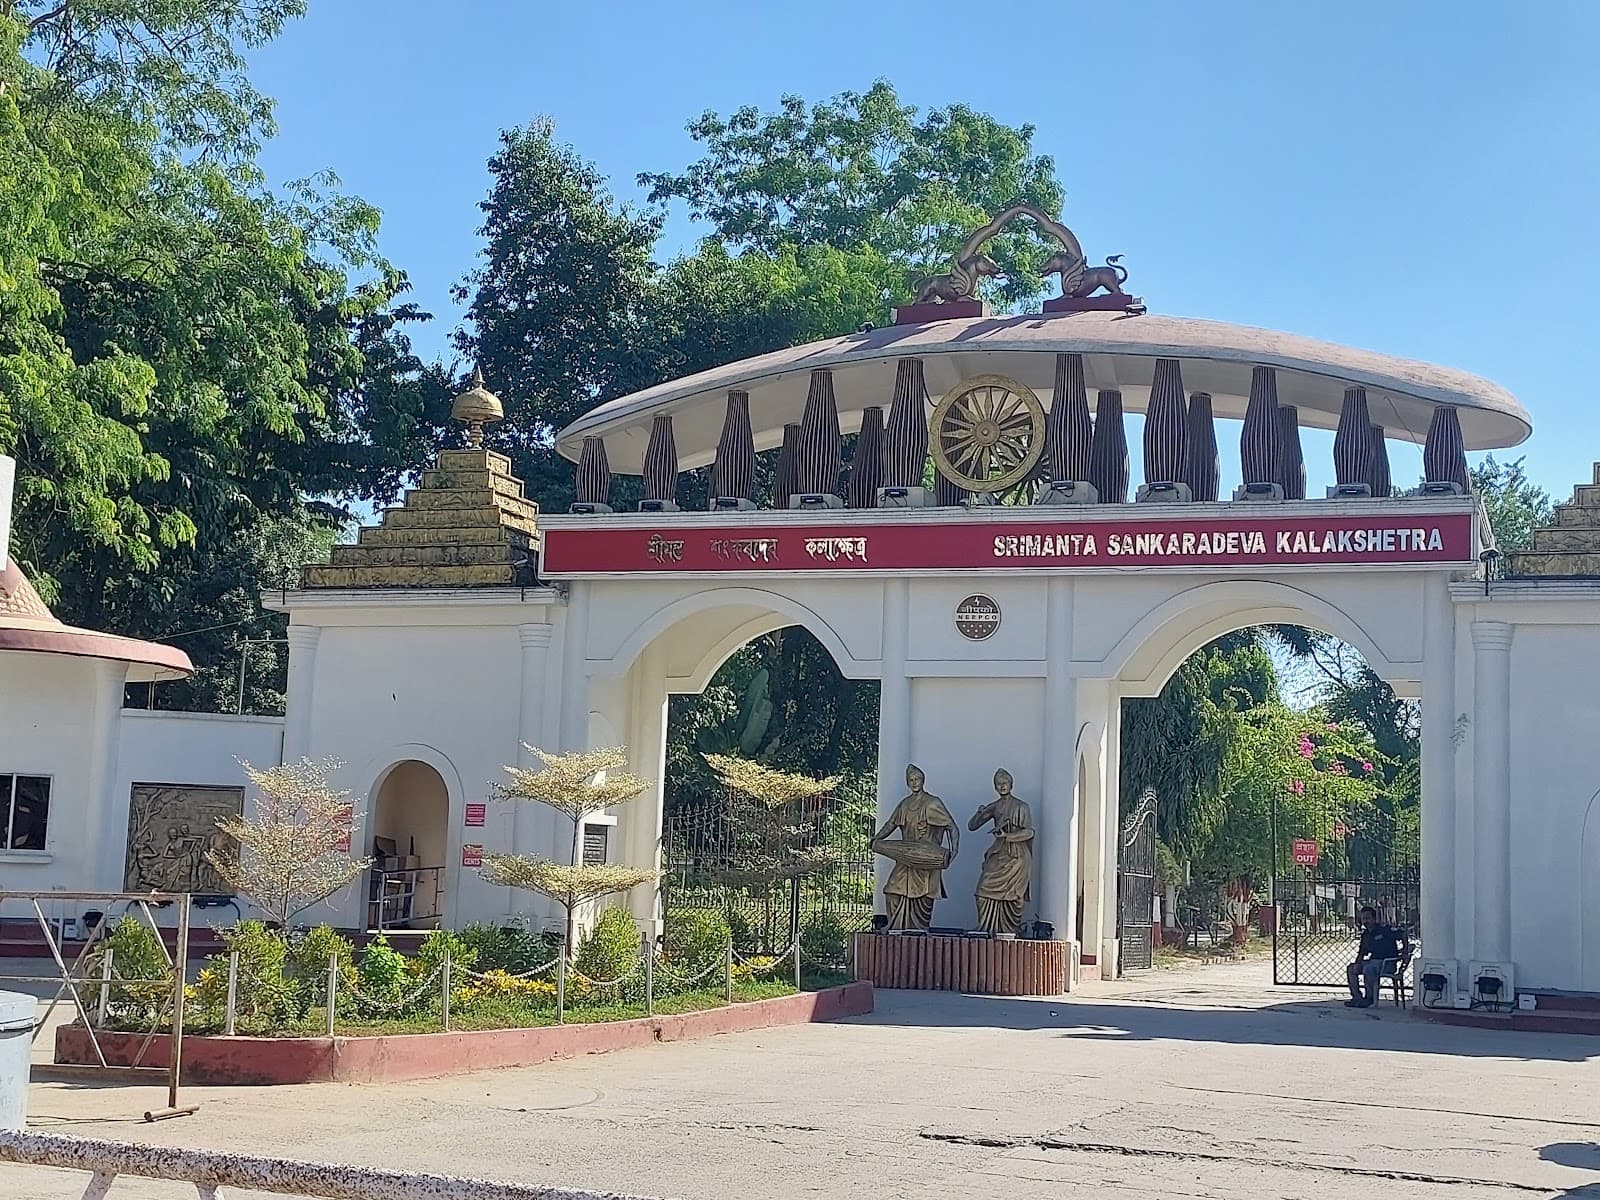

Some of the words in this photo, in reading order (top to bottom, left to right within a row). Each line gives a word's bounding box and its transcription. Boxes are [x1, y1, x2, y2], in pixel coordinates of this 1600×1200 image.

[993, 534, 1098, 558] SRIMANTA
[1106, 531, 1267, 556] SANKARADEVA
[1276, 528, 1444, 554] KALAKSHETRA
[1296, 854, 1315, 863] OUT
